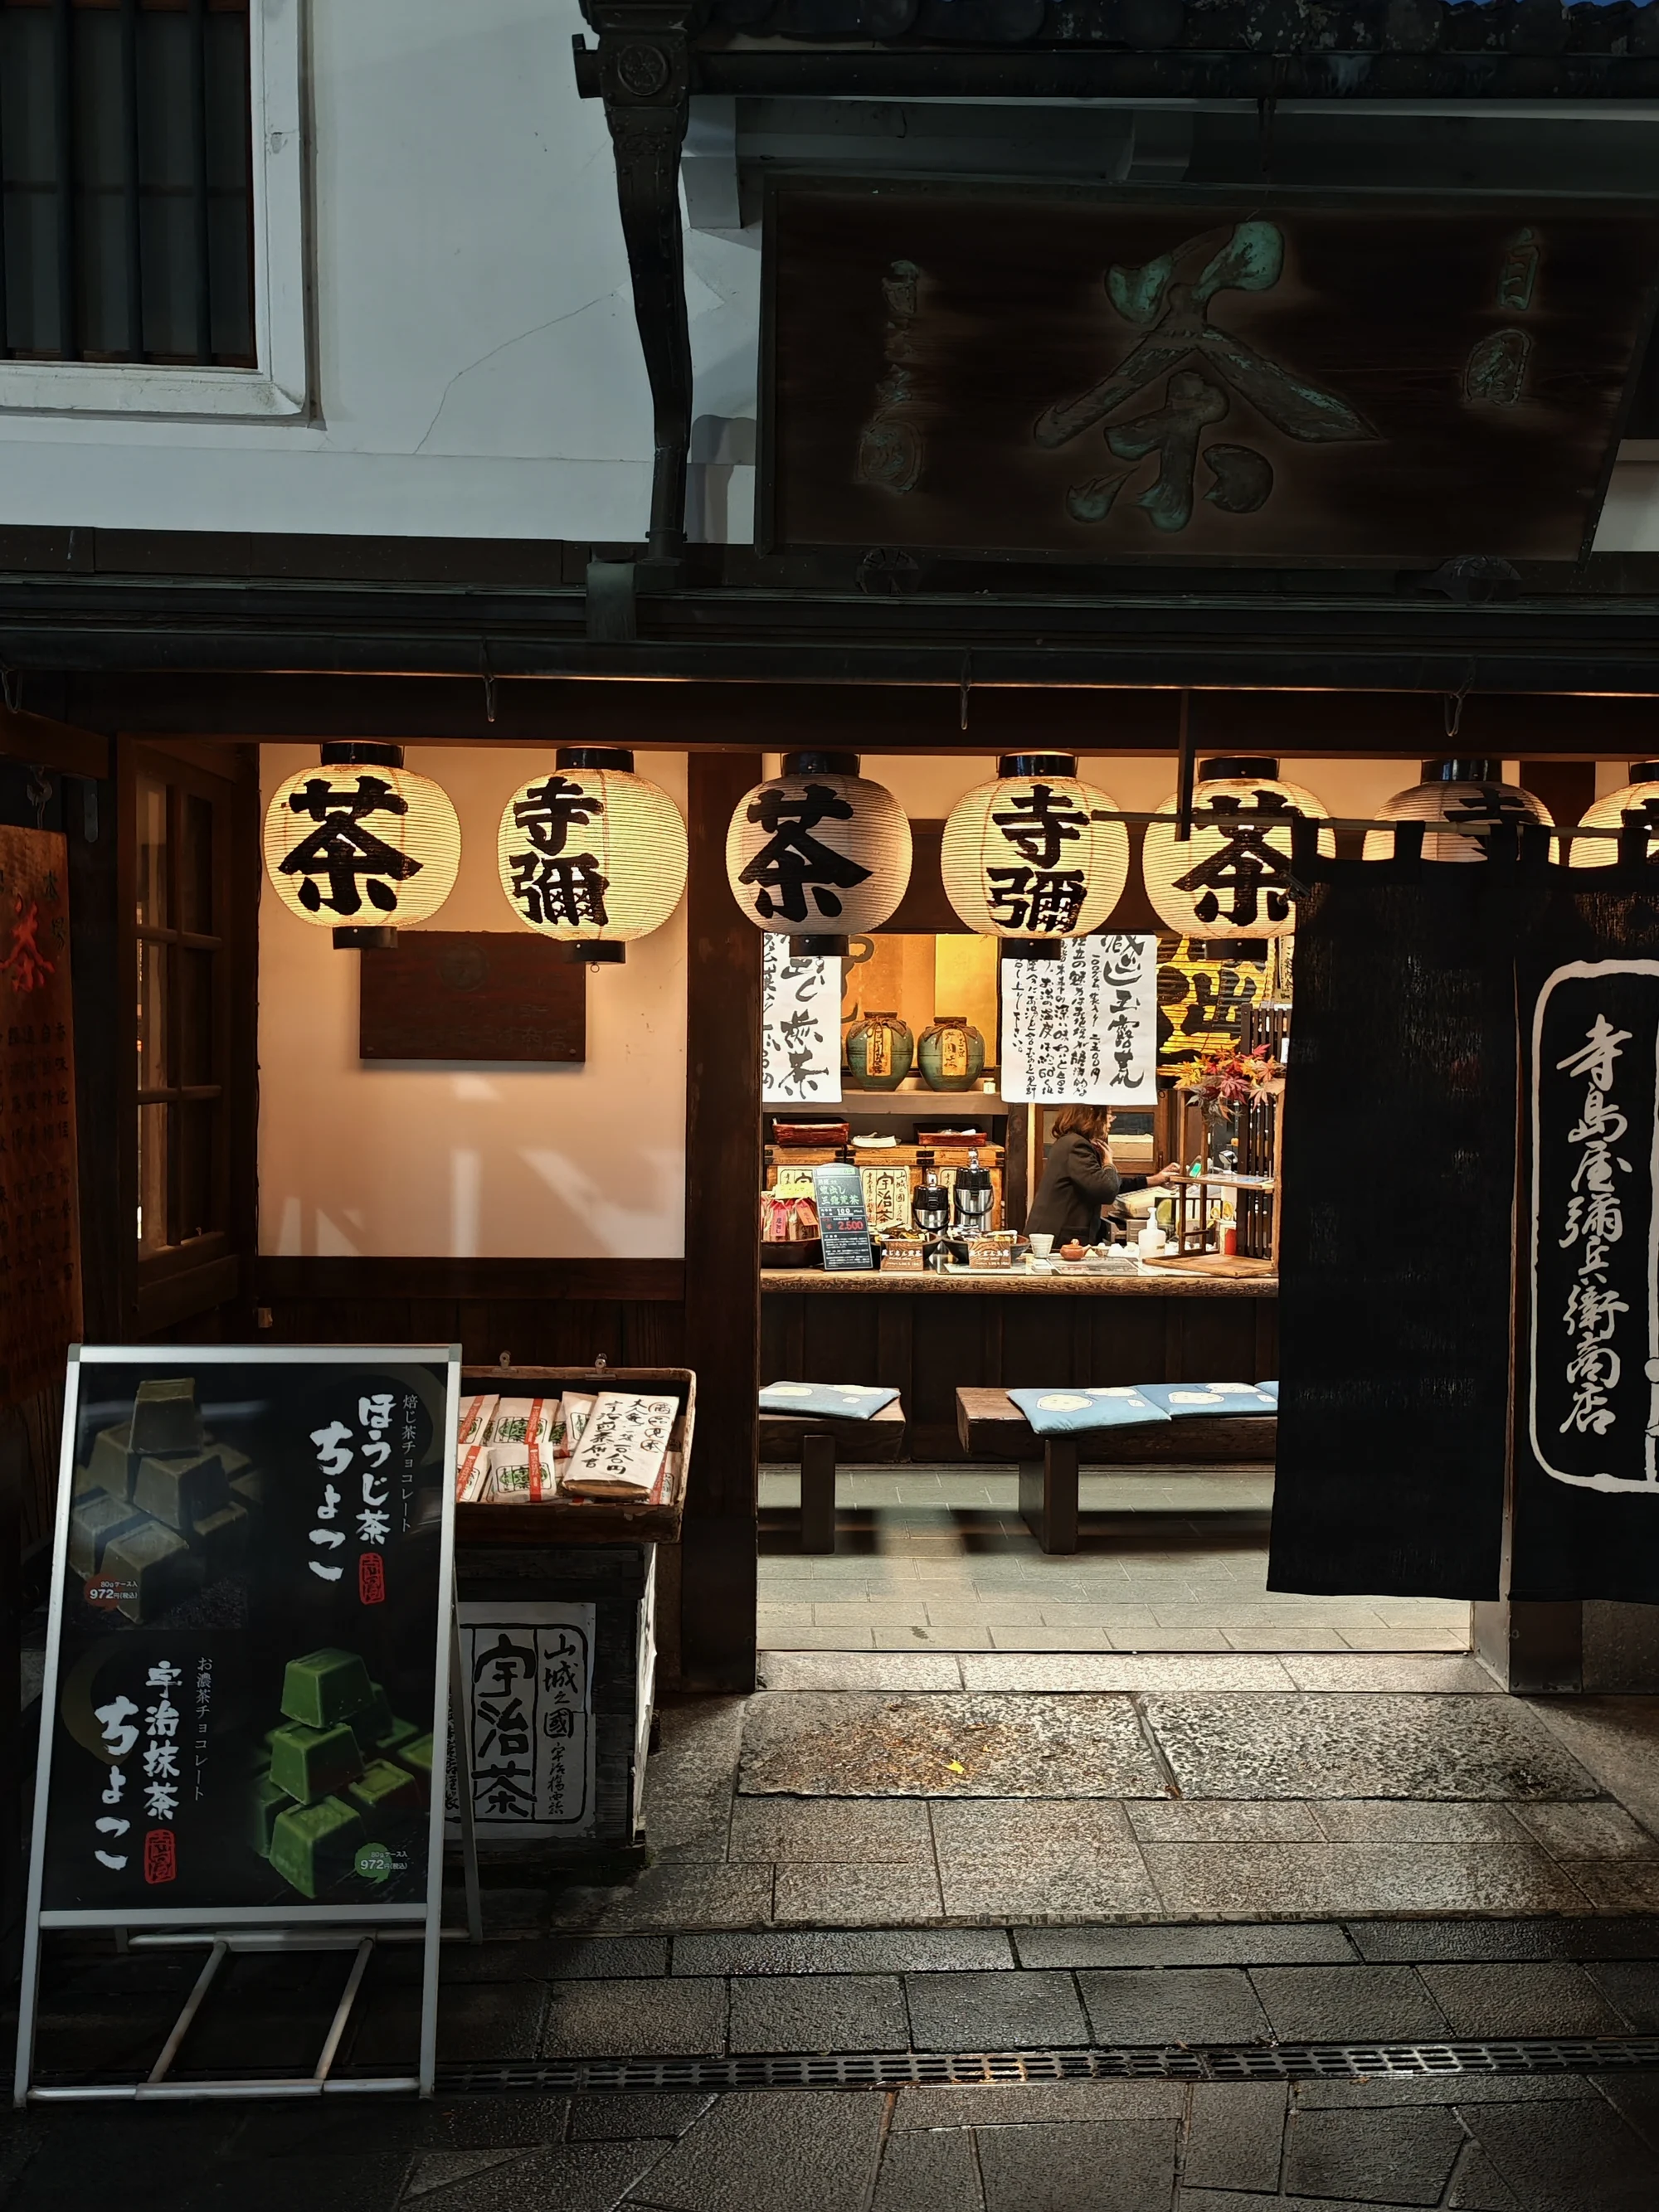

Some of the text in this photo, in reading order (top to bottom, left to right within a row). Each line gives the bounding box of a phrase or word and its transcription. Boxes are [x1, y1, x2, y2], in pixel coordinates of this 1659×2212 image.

[1034, 221, 1383, 532] 茶
[278, 775, 424, 915] 茶
[511, 775, 611, 927] 寺彌
[739, 783, 873, 923] 茶
[986, 784, 1089, 934] 寺彌
[1171, 789, 1304, 926] 茶
[1556, 1014, 1632, 1435] 寺島屋彌兵衛商店
[308, 1420, 354, 1583] ちょこ
[355, 1393, 397, 1545] ほうじ茶
[401, 1394, 419, 1534] 焙じ茶チョコレート
[89, 1588, 139, 1600] 972円(税込)
[95, 1695, 140, 1871] ちょこ
[142, 1660, 182, 1821] 宇治抹茶
[193, 1656, 212, 1801] お濃茶チョコレート
[472, 1634, 538, 1817] 宇治茶
[360, 1859, 408, 1870] 972円(税込)
